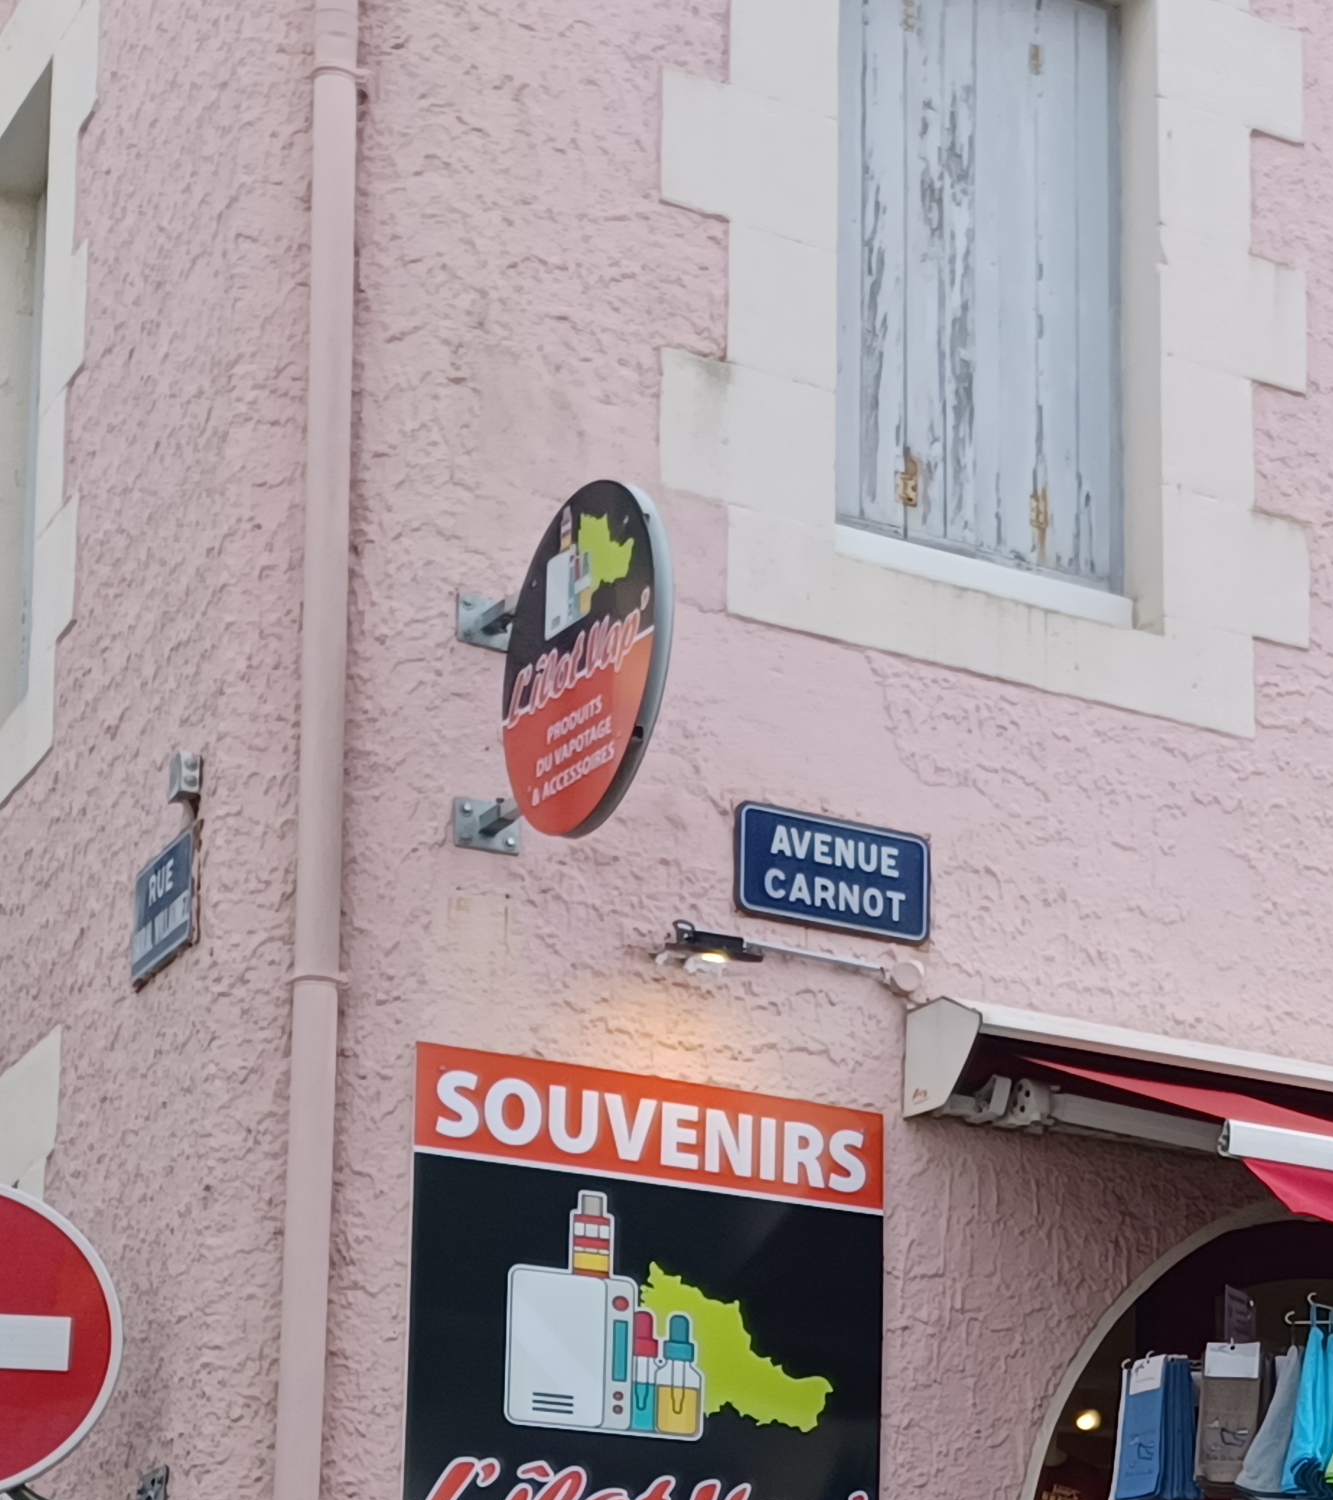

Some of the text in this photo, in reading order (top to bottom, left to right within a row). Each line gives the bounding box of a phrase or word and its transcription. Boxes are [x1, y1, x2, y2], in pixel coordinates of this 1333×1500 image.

[536, 714, 613, 777] DU VAPOTAGE
[546, 694, 603, 745] PRODUITS
[541, 742, 616, 801] ACCESSOIRES
[770, 824, 900, 878] AVENUE
[148, 858, 175, 907] RUE
[764, 867, 906, 922] CARNOT
[435, 1070, 867, 1193] SOUVENIRS
